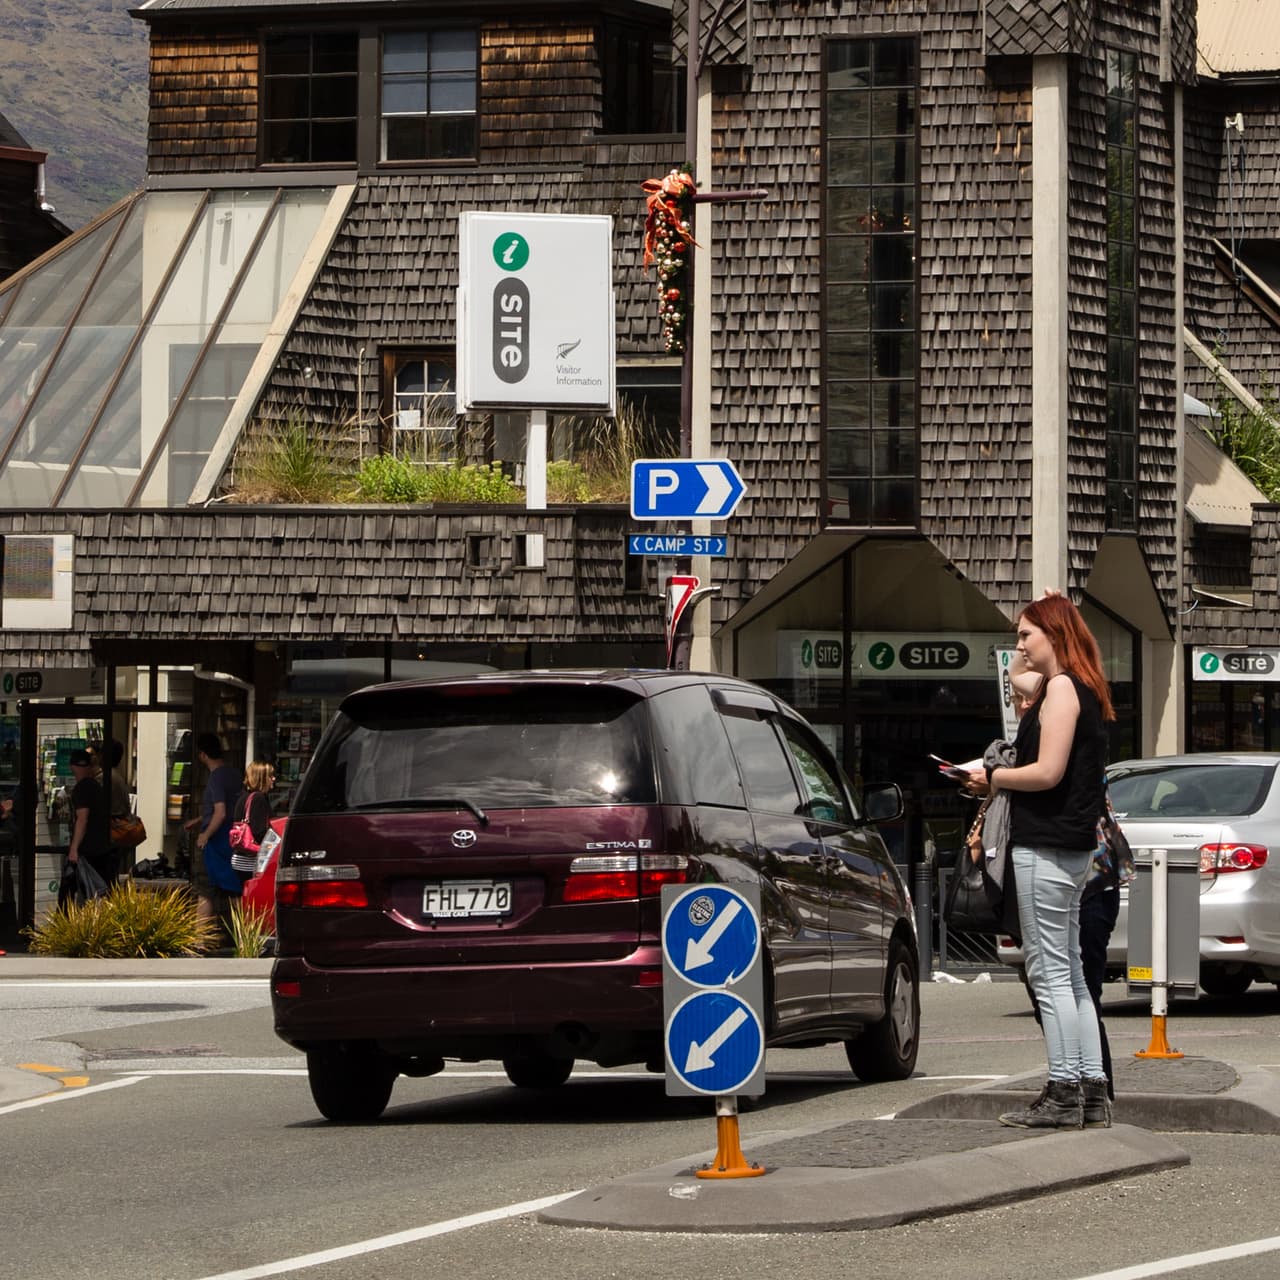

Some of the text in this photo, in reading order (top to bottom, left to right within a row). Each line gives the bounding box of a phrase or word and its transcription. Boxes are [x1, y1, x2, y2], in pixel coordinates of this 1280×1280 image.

[556, 364, 582, 375] Visitor
[556, 375, 603, 386] Information
[648, 469, 680, 510] P
[644, 536, 712, 553] CAMP ST
[586, 841, 636, 850] ESTIMA
[426, 887, 508, 912] FHL770
